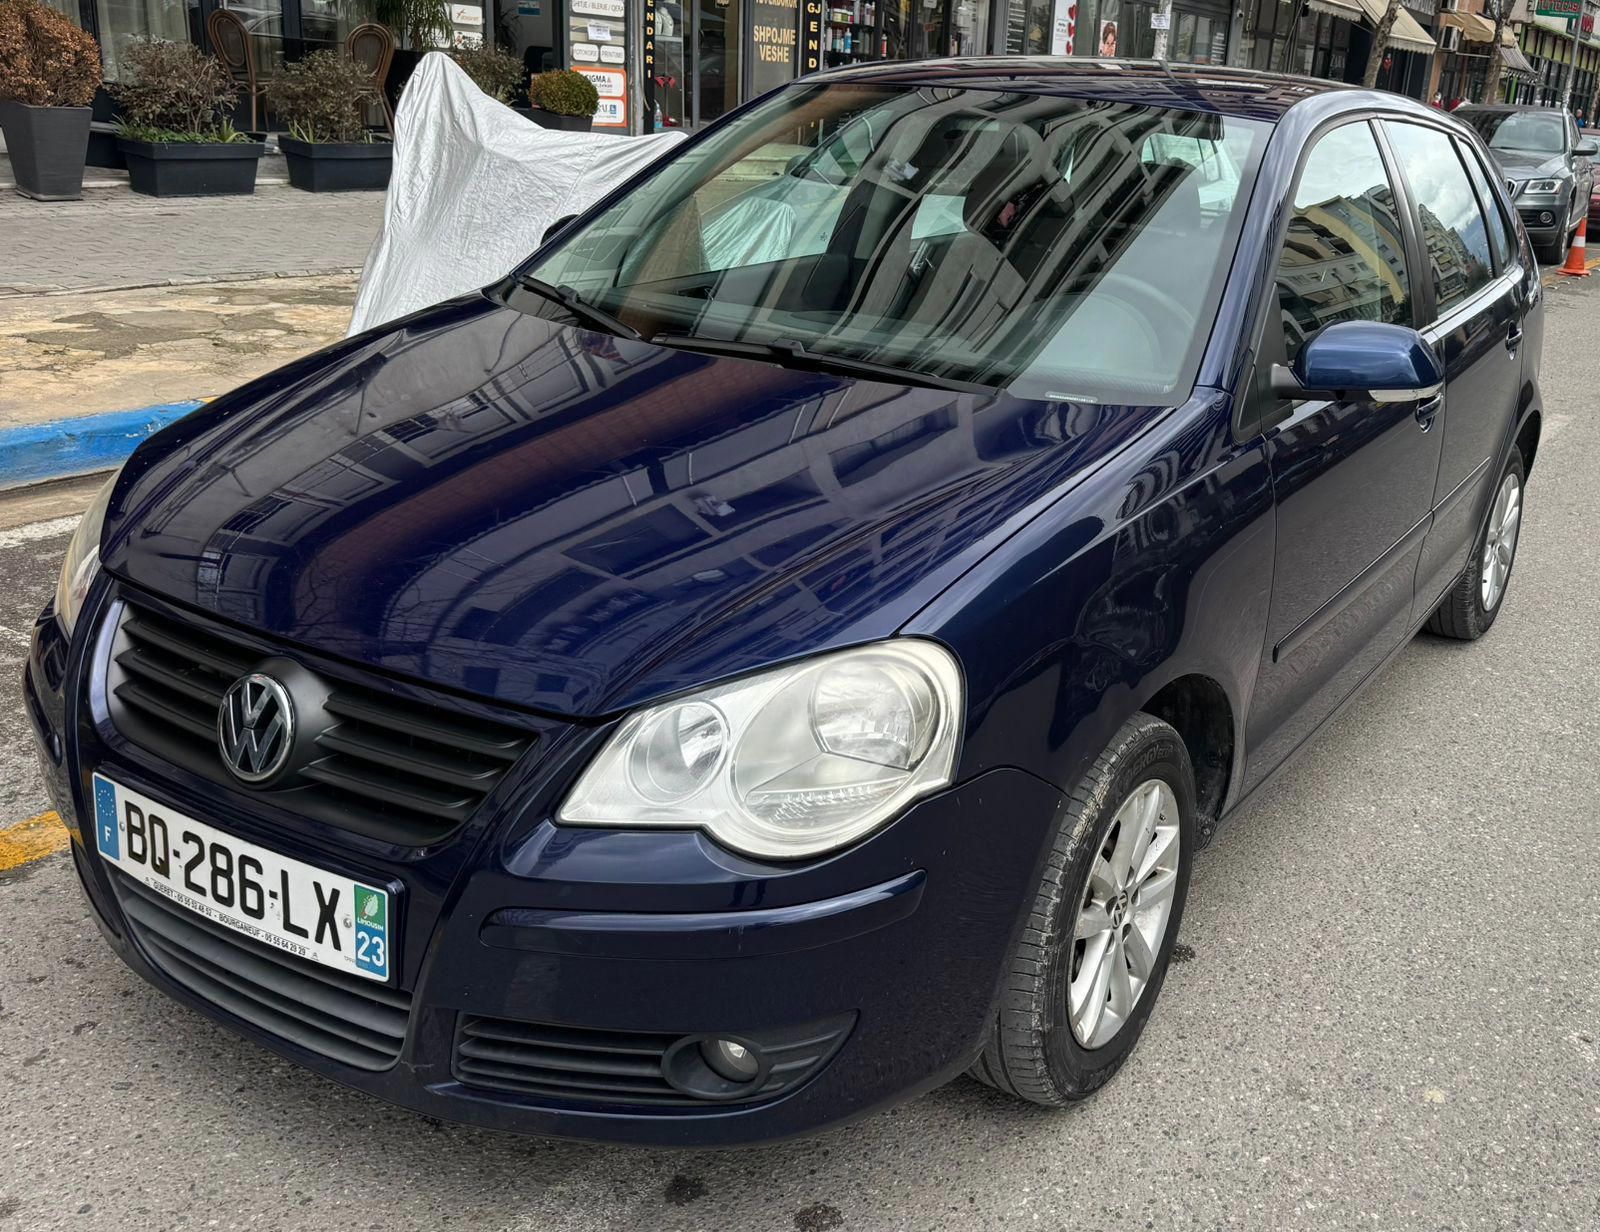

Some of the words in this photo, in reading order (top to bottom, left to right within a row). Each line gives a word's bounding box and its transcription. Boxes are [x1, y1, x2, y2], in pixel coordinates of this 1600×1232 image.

[753, 25, 796, 45] SHPOJME
[759, 44, 789, 62] VESHE
[104, 825, 111, 842] F
[125, 800, 342, 952] BQ-286-LX
[357, 917, 384, 932] LIMOUSIN
[272, 937, 281, 945] 55
[357, 931, 385, 967] 23
